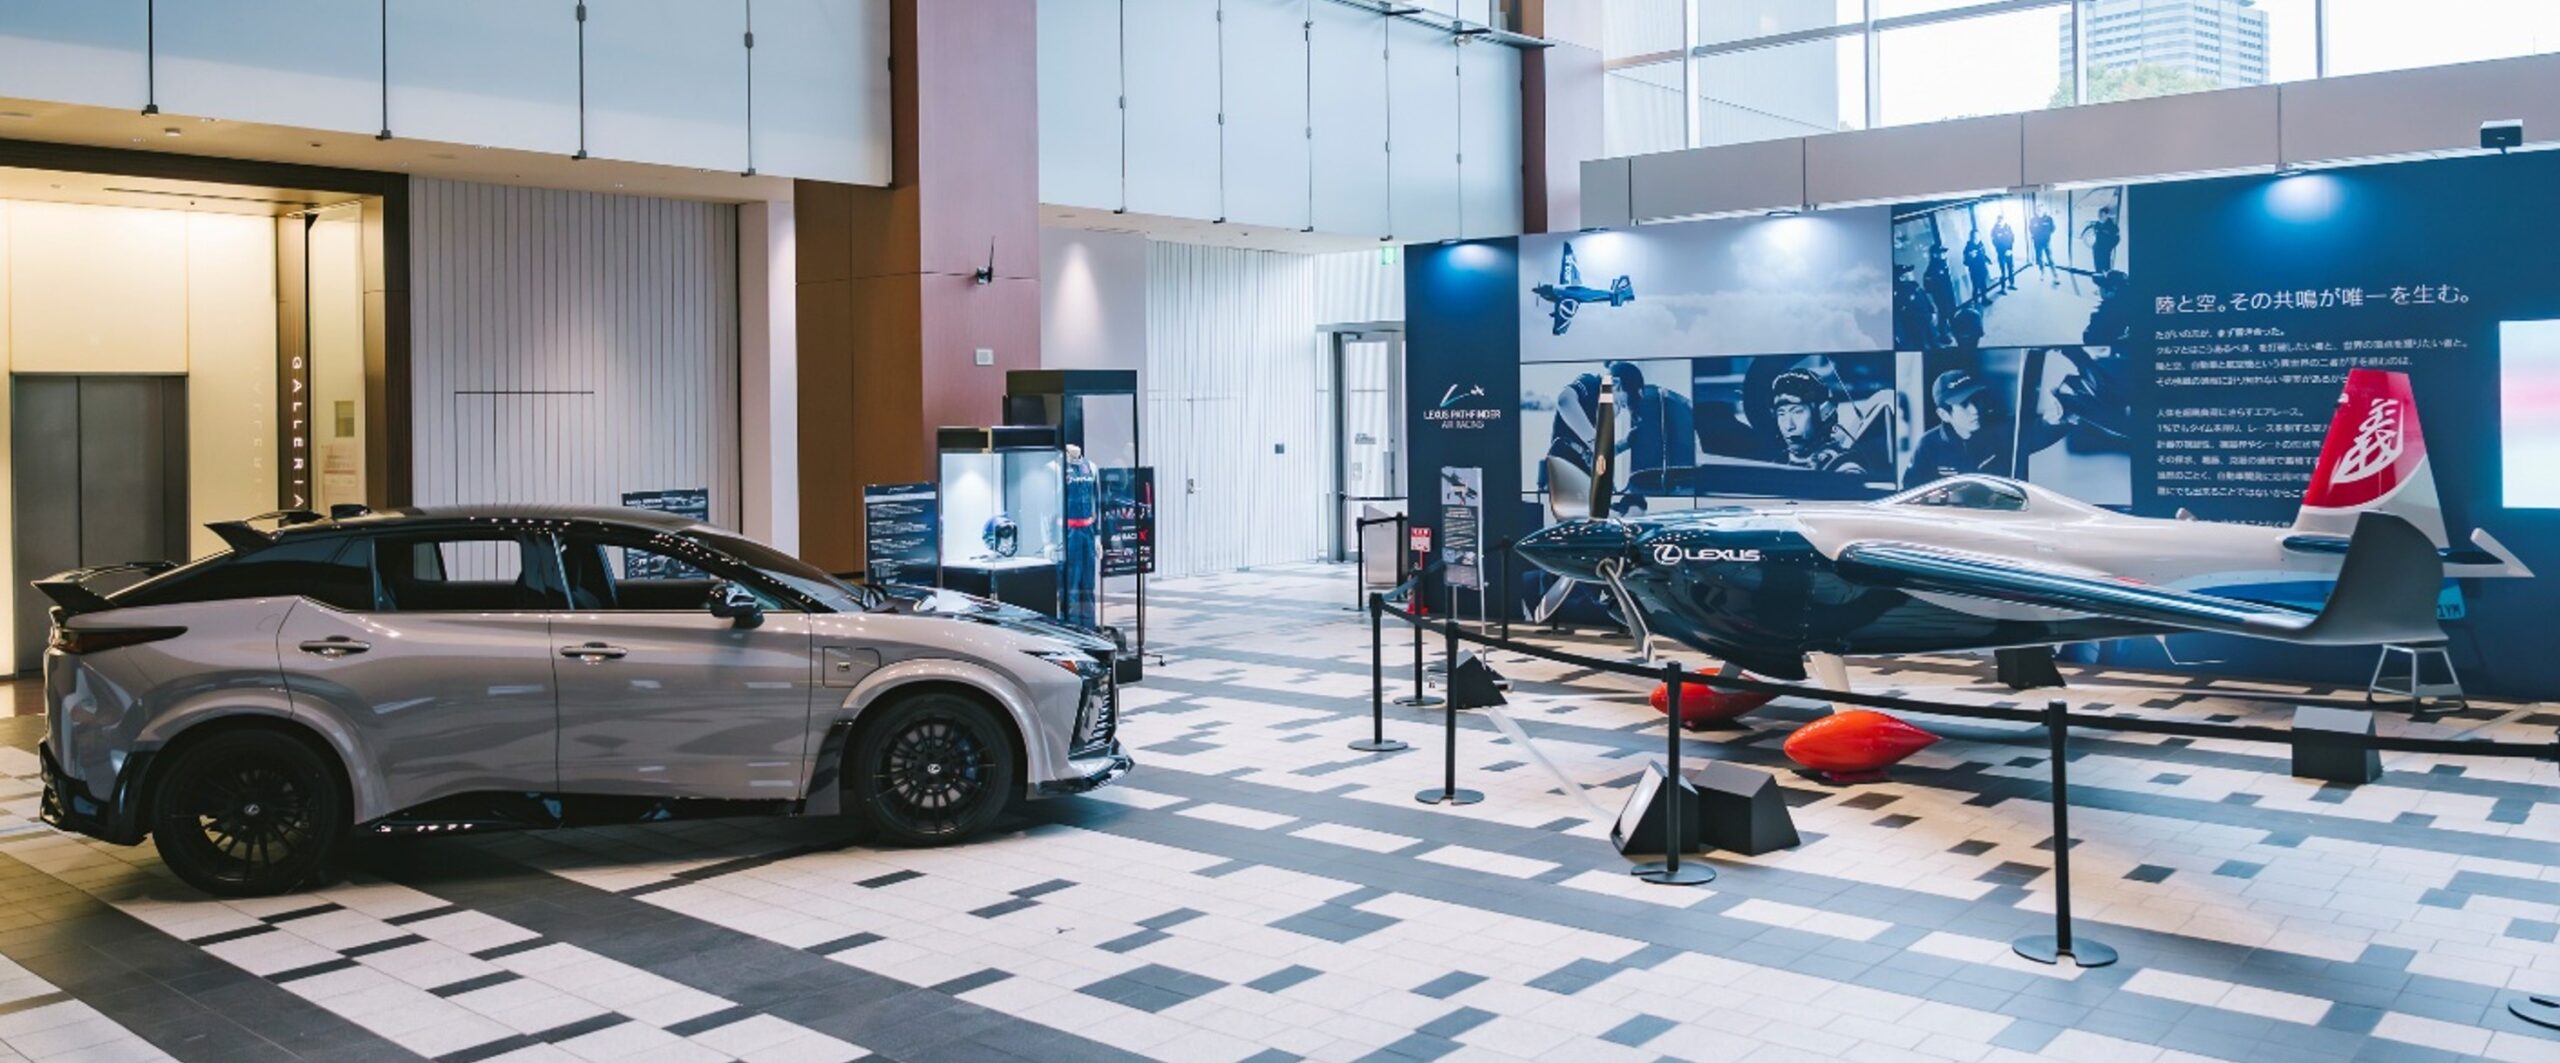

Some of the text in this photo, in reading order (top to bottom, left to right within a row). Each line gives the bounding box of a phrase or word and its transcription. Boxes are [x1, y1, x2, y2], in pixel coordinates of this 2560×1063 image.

[2155, 284, 2469, 314] 陸と空。その共鳴が唯一を生む。
[1423, 409, 1501, 420] LEXUS PATHFINDER
[292, 356, 304, 507] GALLERIA
[1684, 548, 1760, 562] LEXUS
